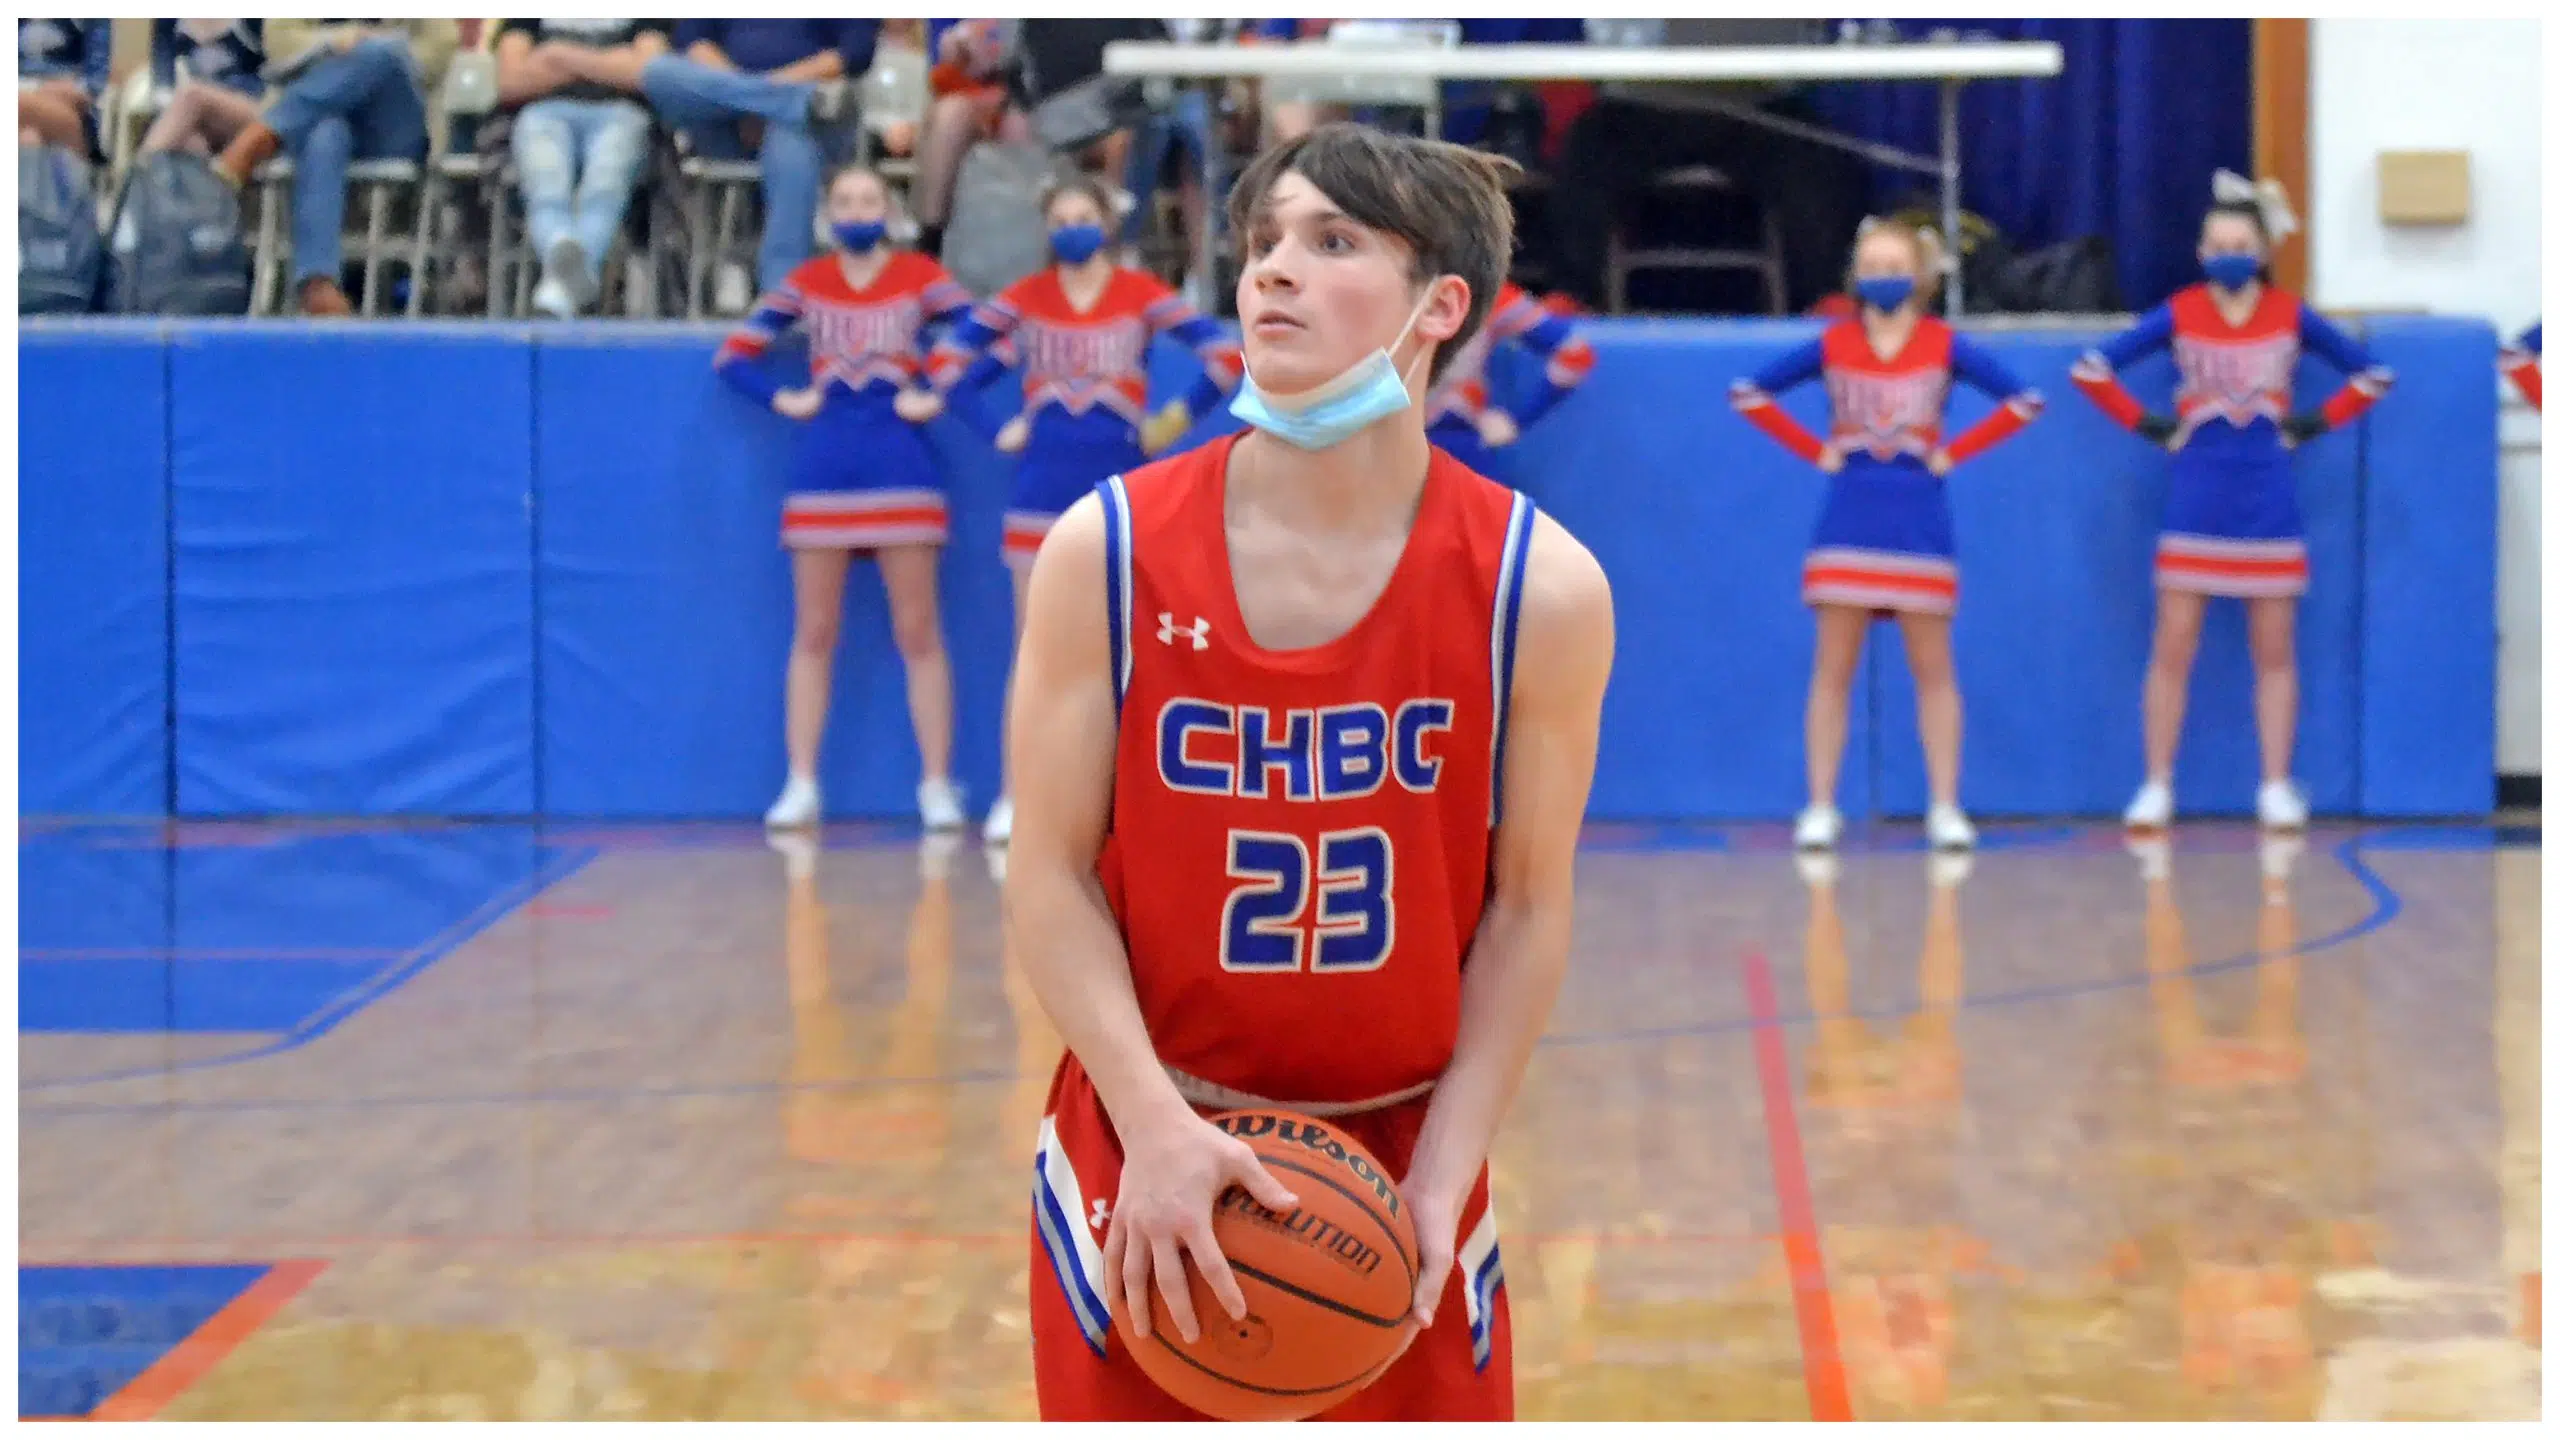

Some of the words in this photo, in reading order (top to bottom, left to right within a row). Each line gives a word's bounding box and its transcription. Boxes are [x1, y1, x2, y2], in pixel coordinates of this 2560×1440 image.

[1156, 697, 1454, 802] CHBC
[1219, 826, 1396, 974] 23
[1215, 1114, 1399, 1220] Wilson
